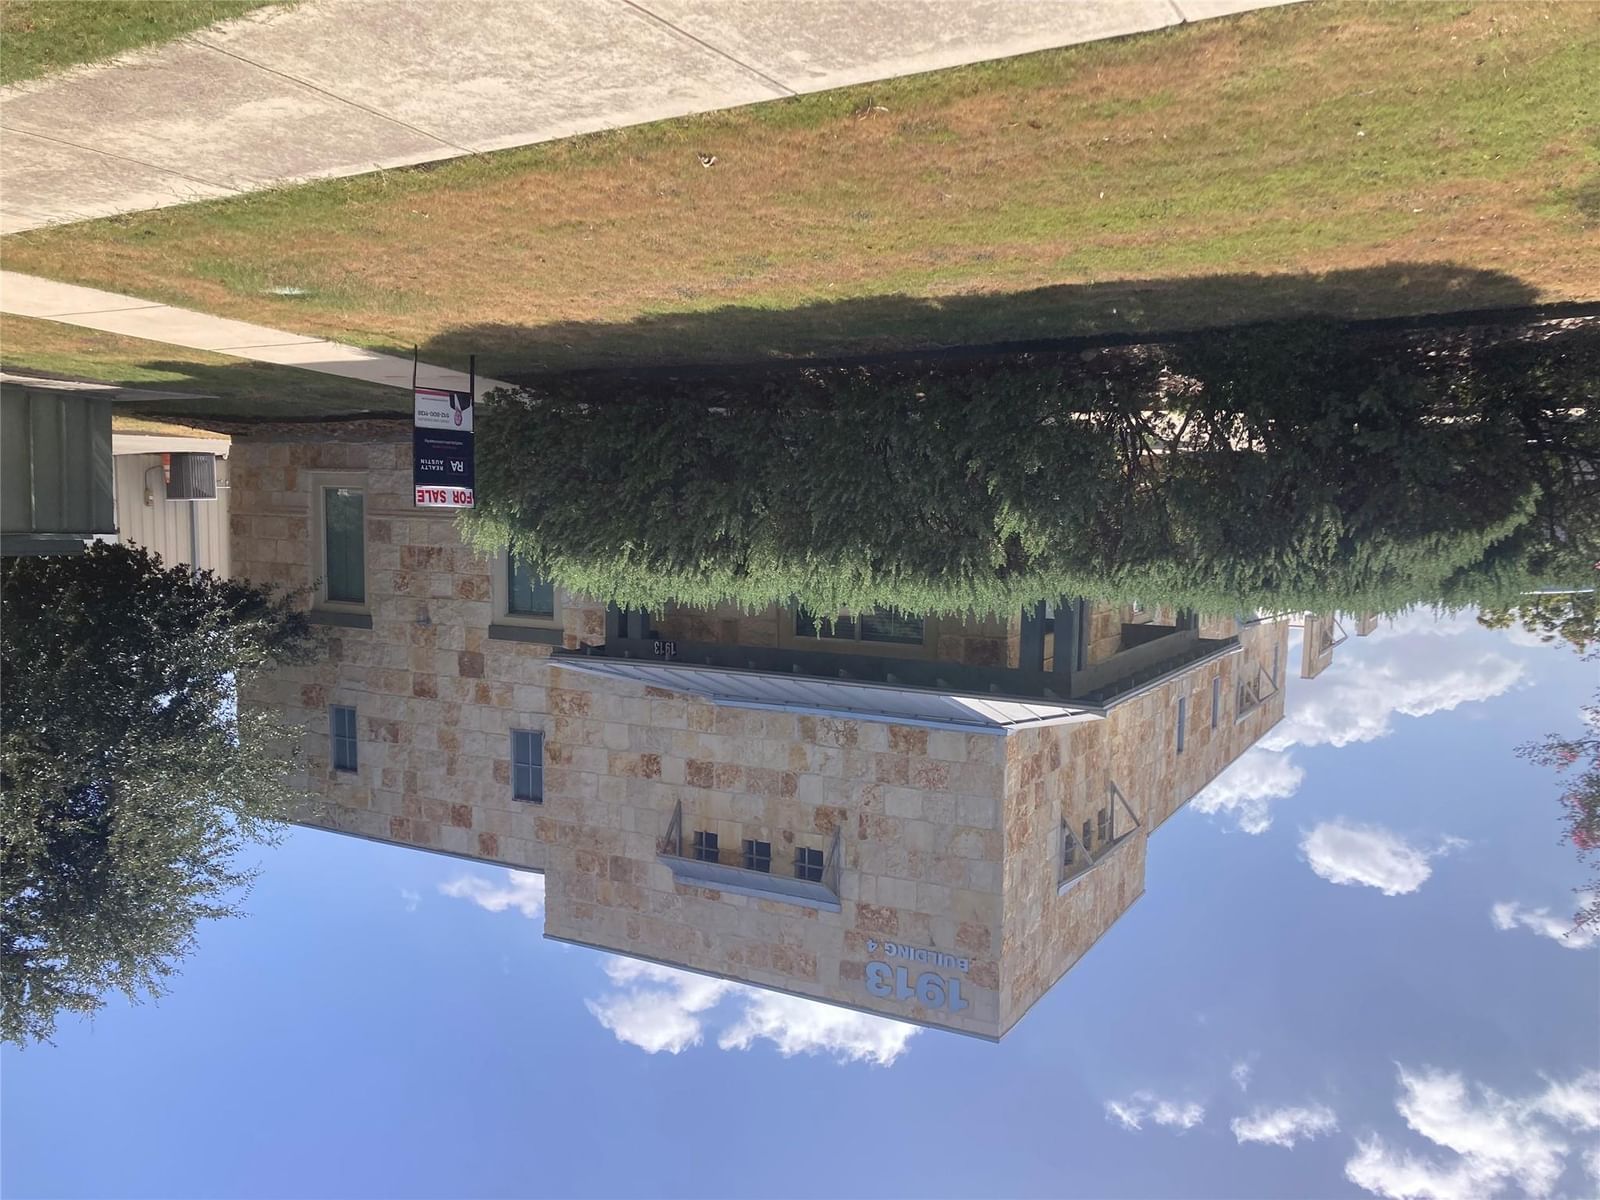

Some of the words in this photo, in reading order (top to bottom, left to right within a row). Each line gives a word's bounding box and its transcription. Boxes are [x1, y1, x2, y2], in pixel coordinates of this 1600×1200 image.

[450, 460, 464, 471] RA
[417, 490, 446, 503] SALE
[453, 490, 473, 504] FOR
[654, 641, 676, 655] 1913
[866, 939, 878, 953] 4
[885, 942, 969, 973] BUILDING
[865, 961, 969, 1013] 1913
